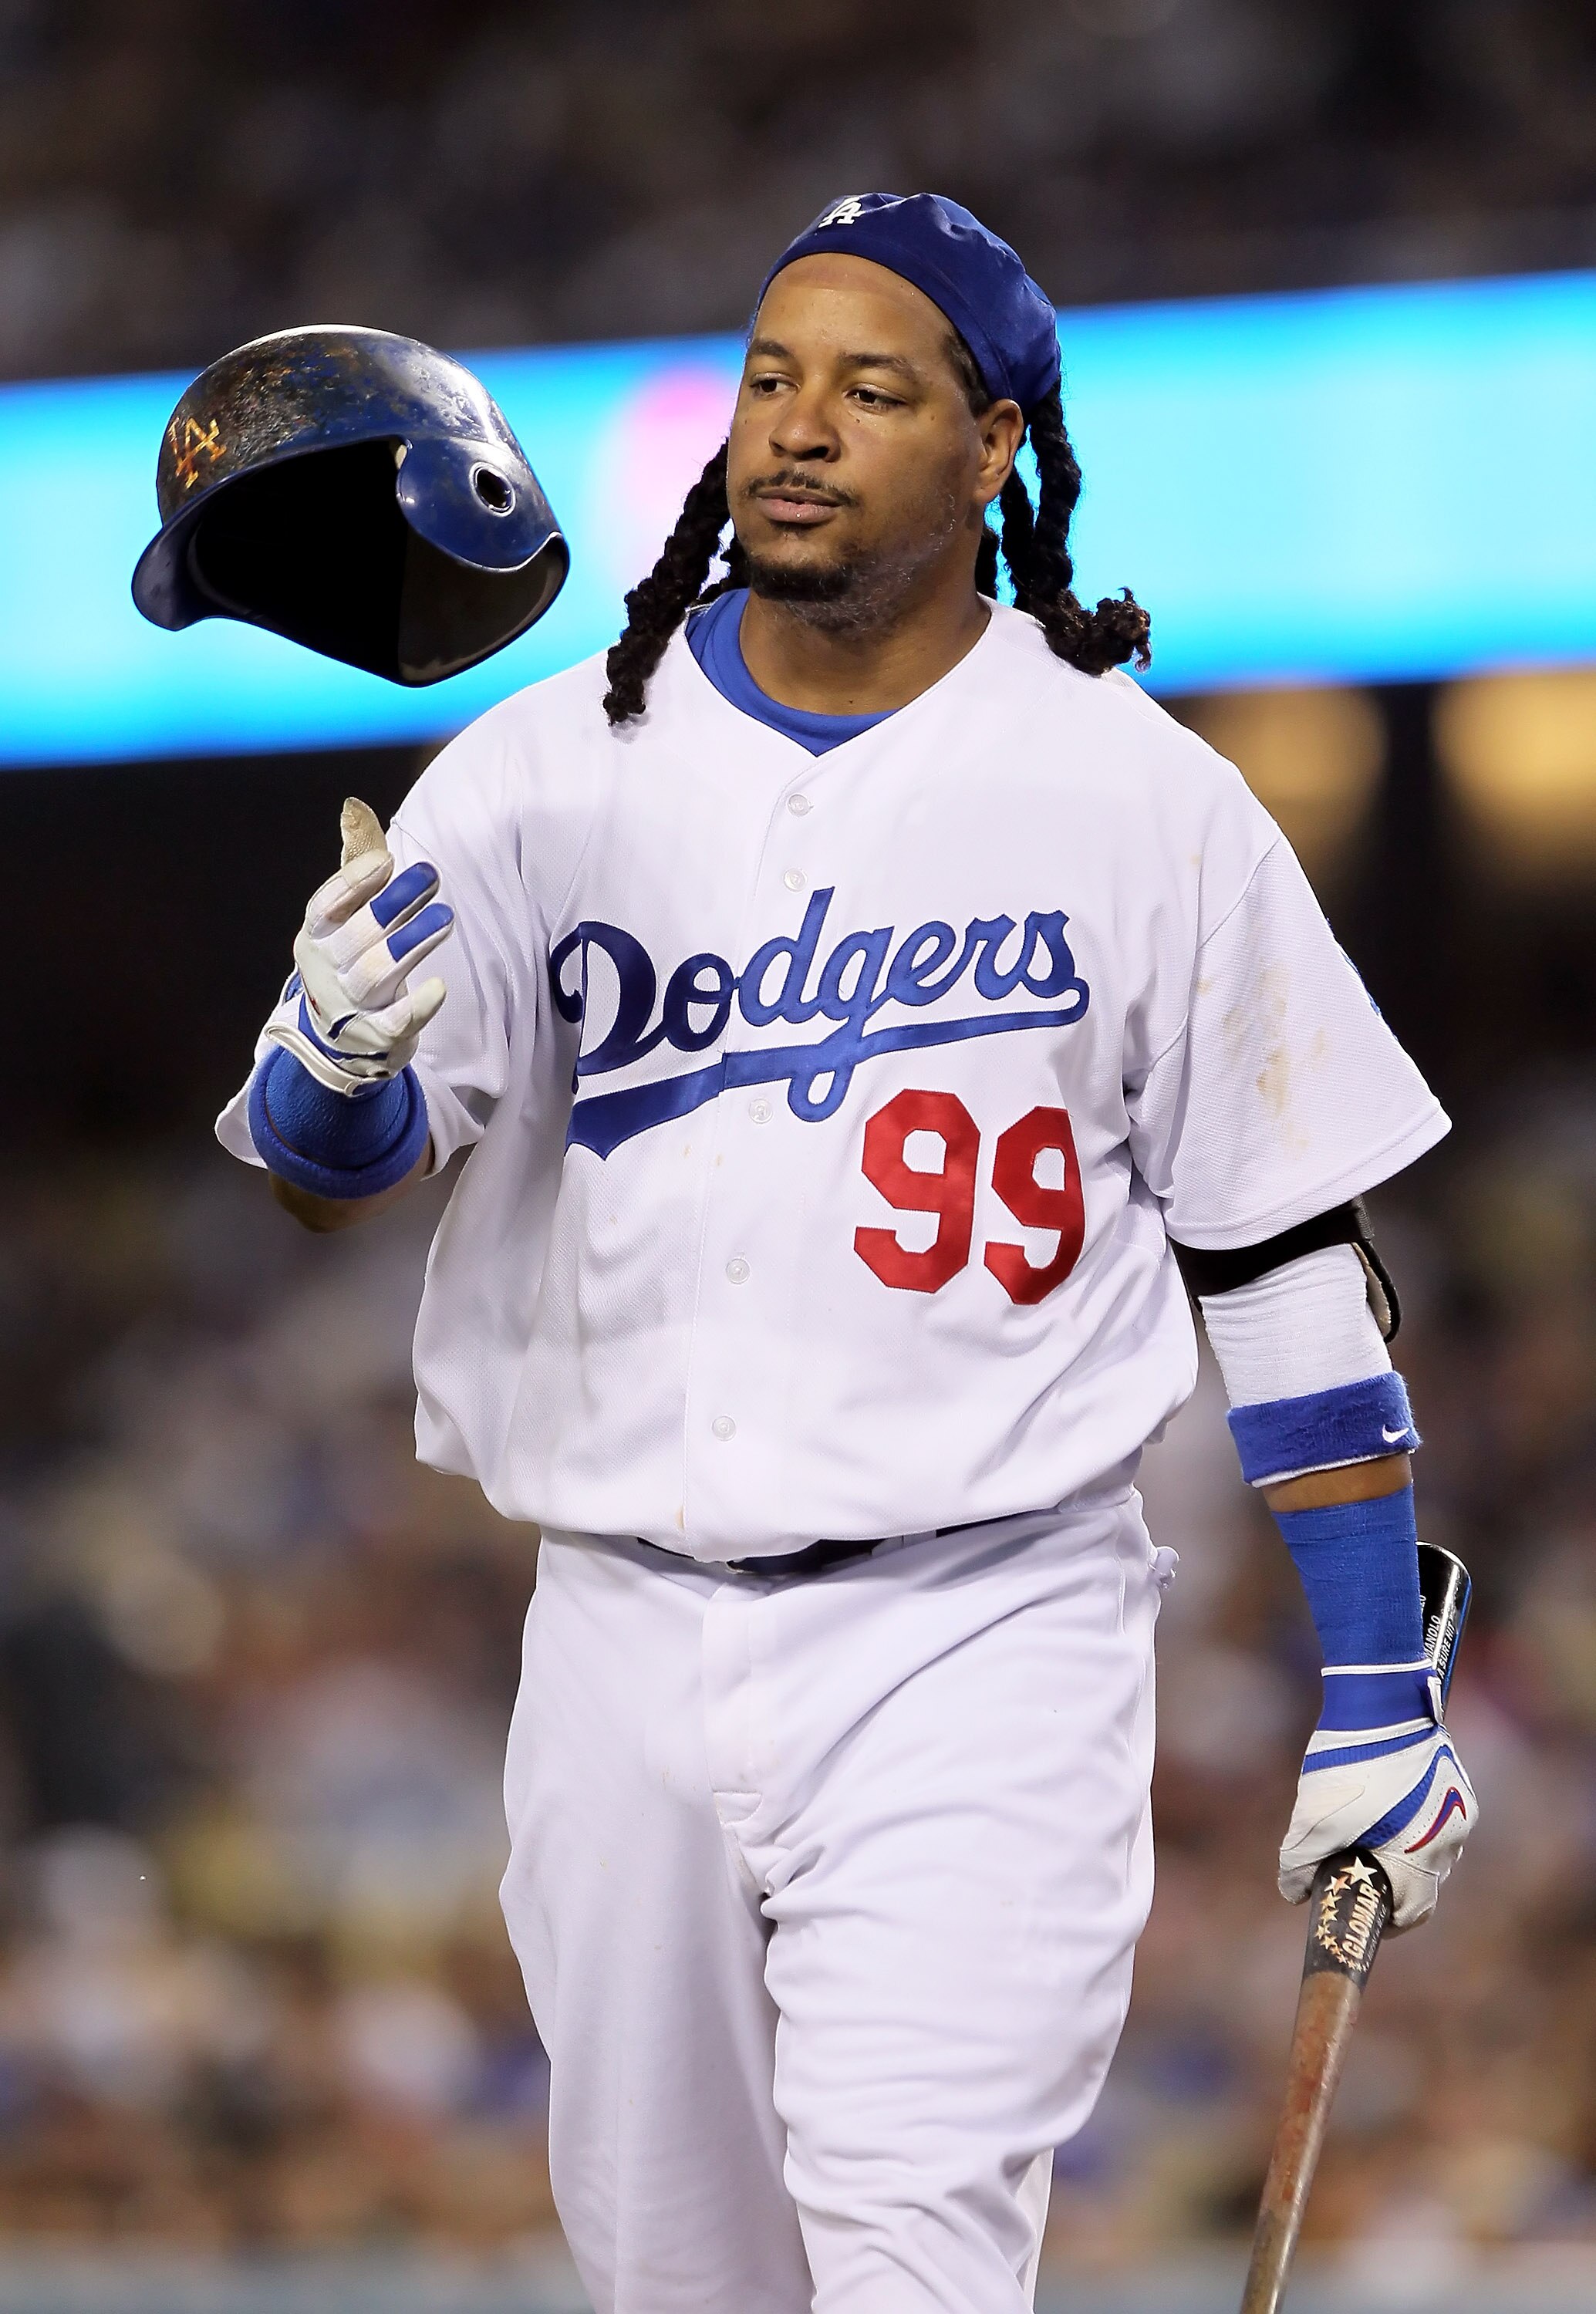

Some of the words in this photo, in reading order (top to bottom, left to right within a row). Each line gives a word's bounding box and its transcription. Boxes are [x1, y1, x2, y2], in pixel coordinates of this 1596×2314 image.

[167, 416, 228, 490] LA
[549, 886, 1089, 1124] Dodgers
[854, 1088, 1086, 1306] 99
[1438, 1637, 1451, 1670] SURE
[1445, 1621, 1455, 1641] HIT
[1341, 1882, 1382, 1960] GLOMAR
